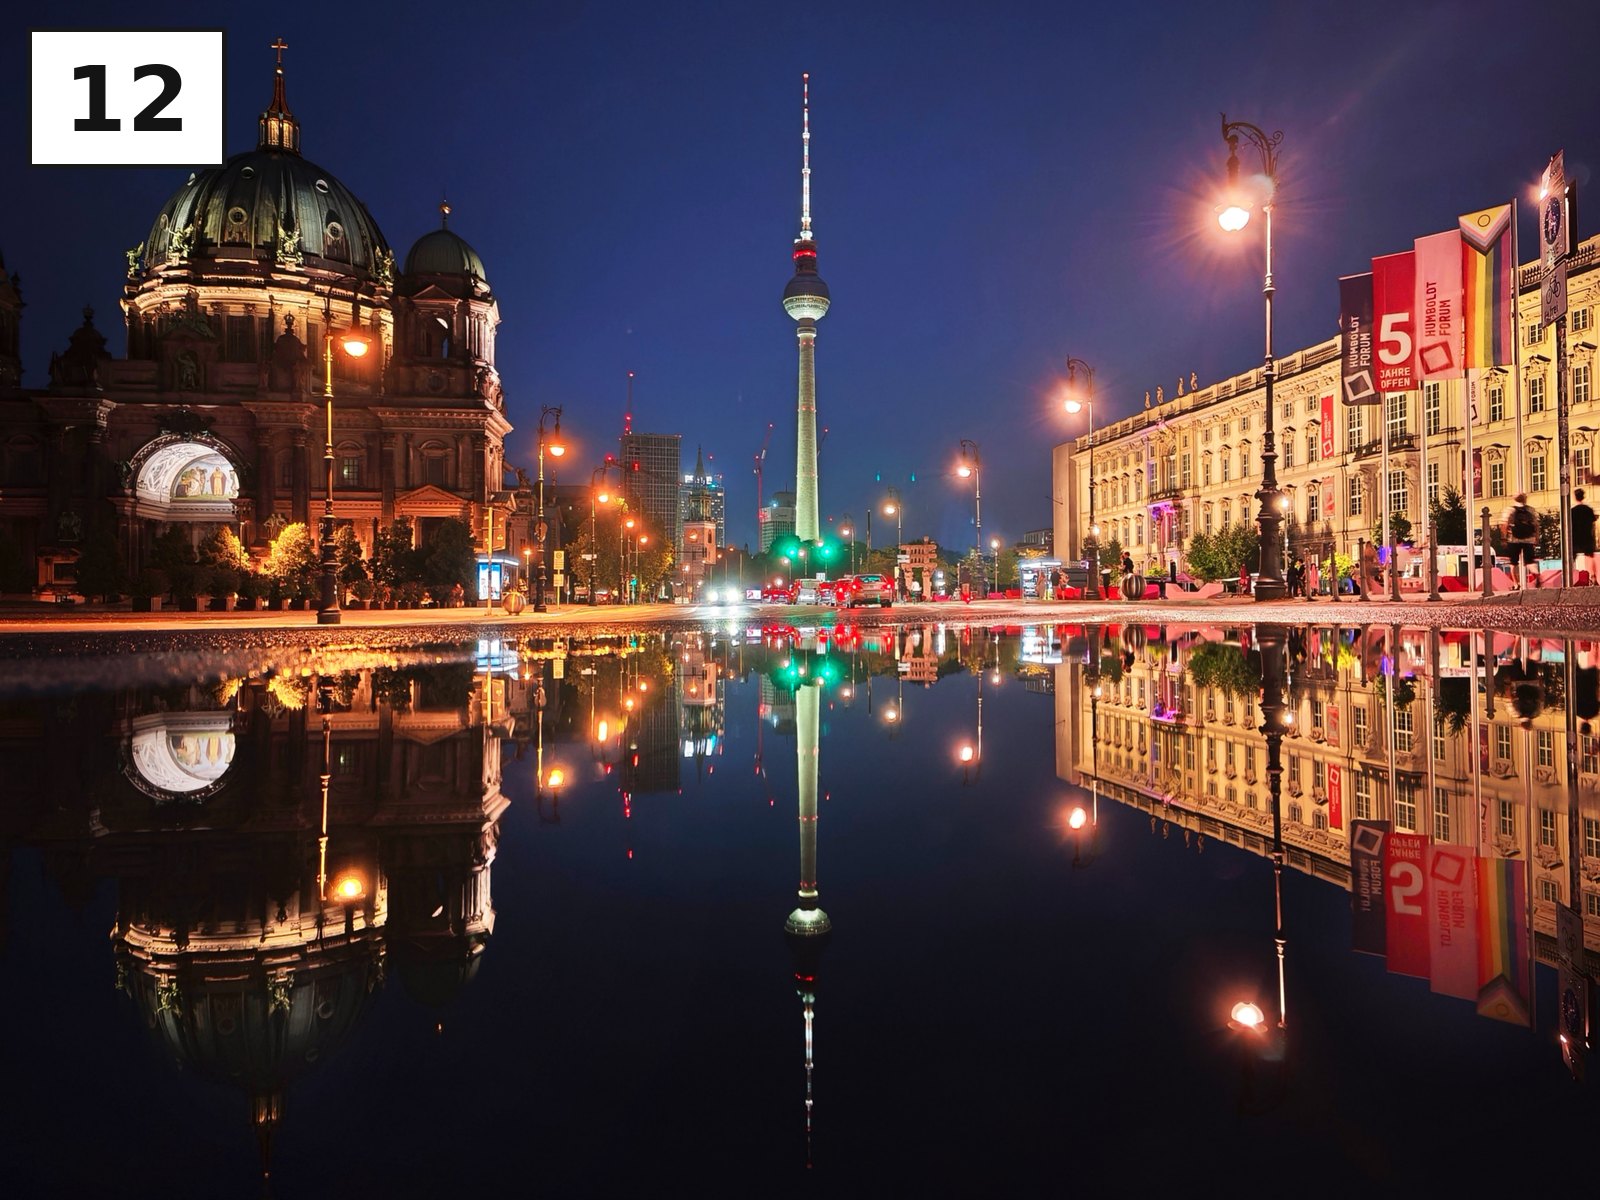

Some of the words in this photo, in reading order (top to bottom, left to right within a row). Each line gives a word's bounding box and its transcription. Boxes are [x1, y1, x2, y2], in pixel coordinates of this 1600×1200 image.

[1425, 282, 1437, 337] HUMBOLDT
[1439, 299, 1451, 336] FORUM
[1349, 316, 1360, 368] HUMBOLDT
[1360, 333, 1371, 367] FORUM
[1378, 312, 1412, 365] 5
[1380, 367, 1411, 379] JAHRE
[1381, 377, 1411, 389] OFFEN
